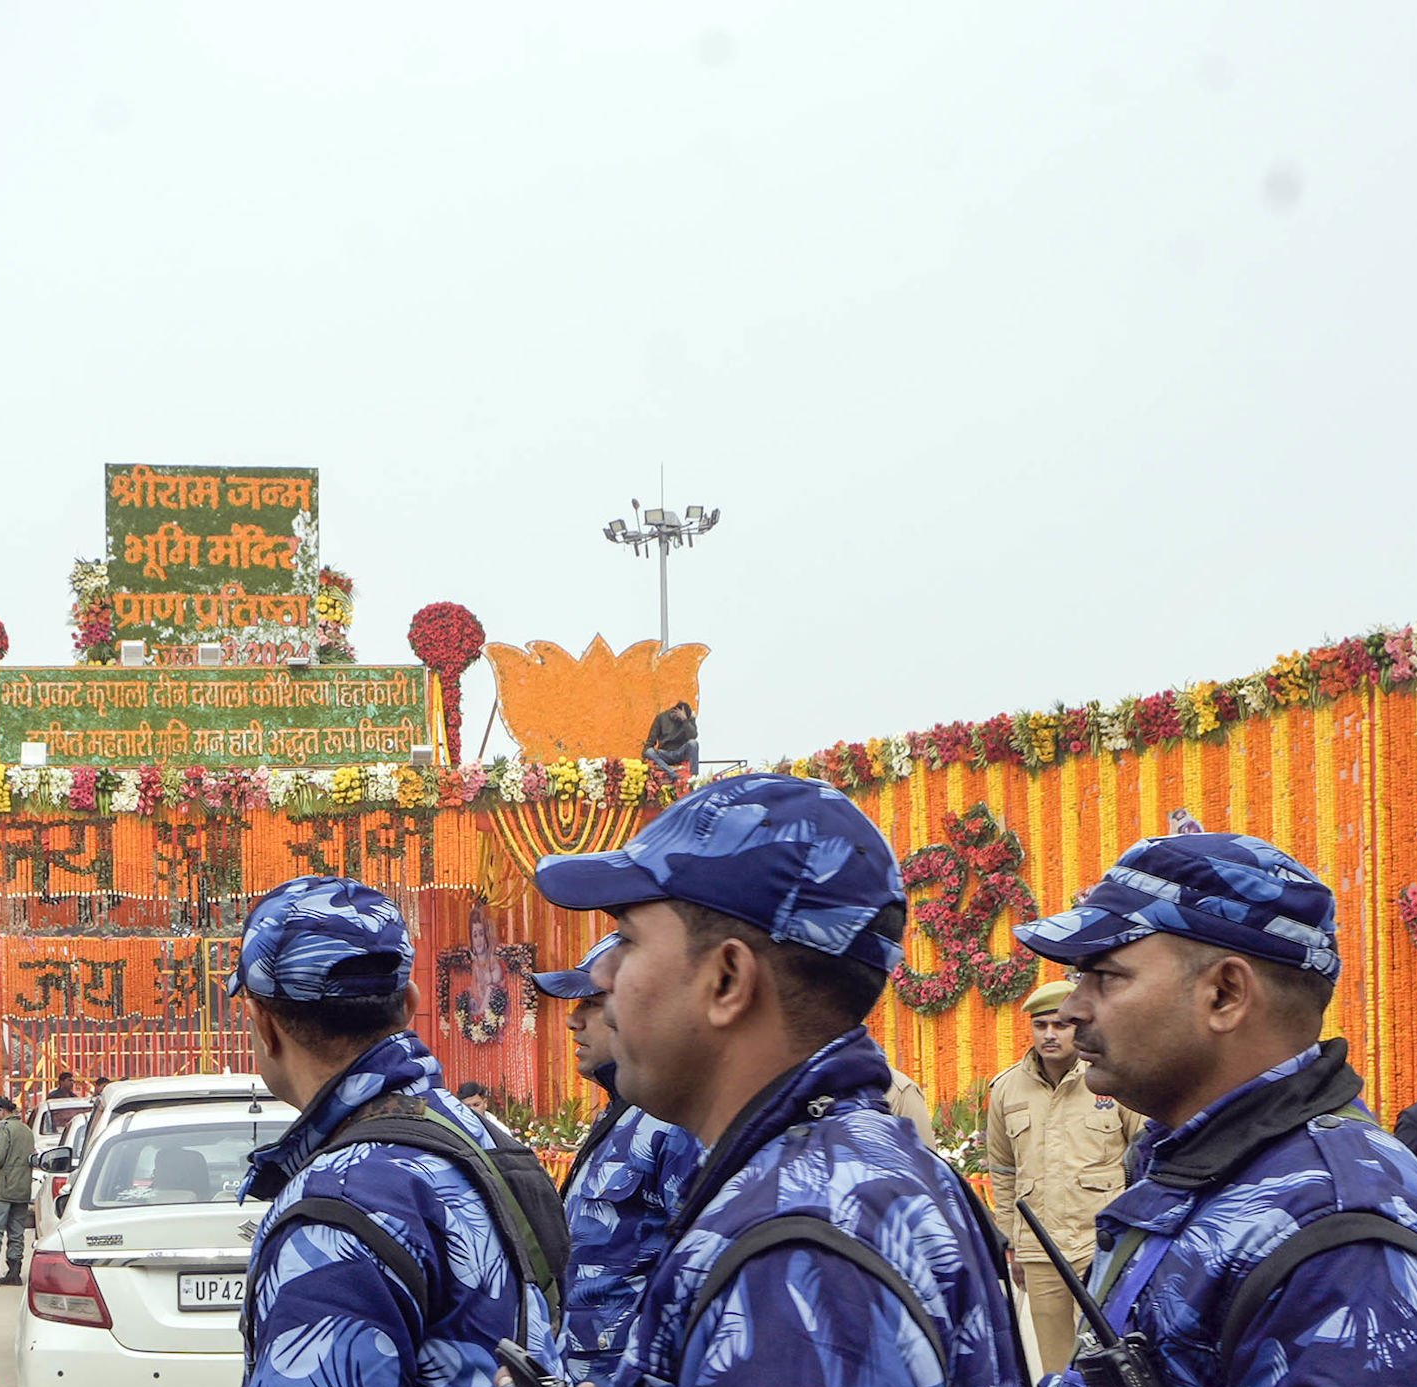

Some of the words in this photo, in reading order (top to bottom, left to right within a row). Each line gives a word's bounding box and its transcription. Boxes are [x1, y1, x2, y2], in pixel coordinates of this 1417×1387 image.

[111, 464, 221, 510] श्रीराम
[226, 475, 313, 511] जन्म
[124, 521, 201, 581] भूमि
[206, 522, 302, 569] मंदिर
[112, 592, 188, 630] प्राण
[152, 636, 239, 666] जनरी
[152, 672, 188, 708] दीन
